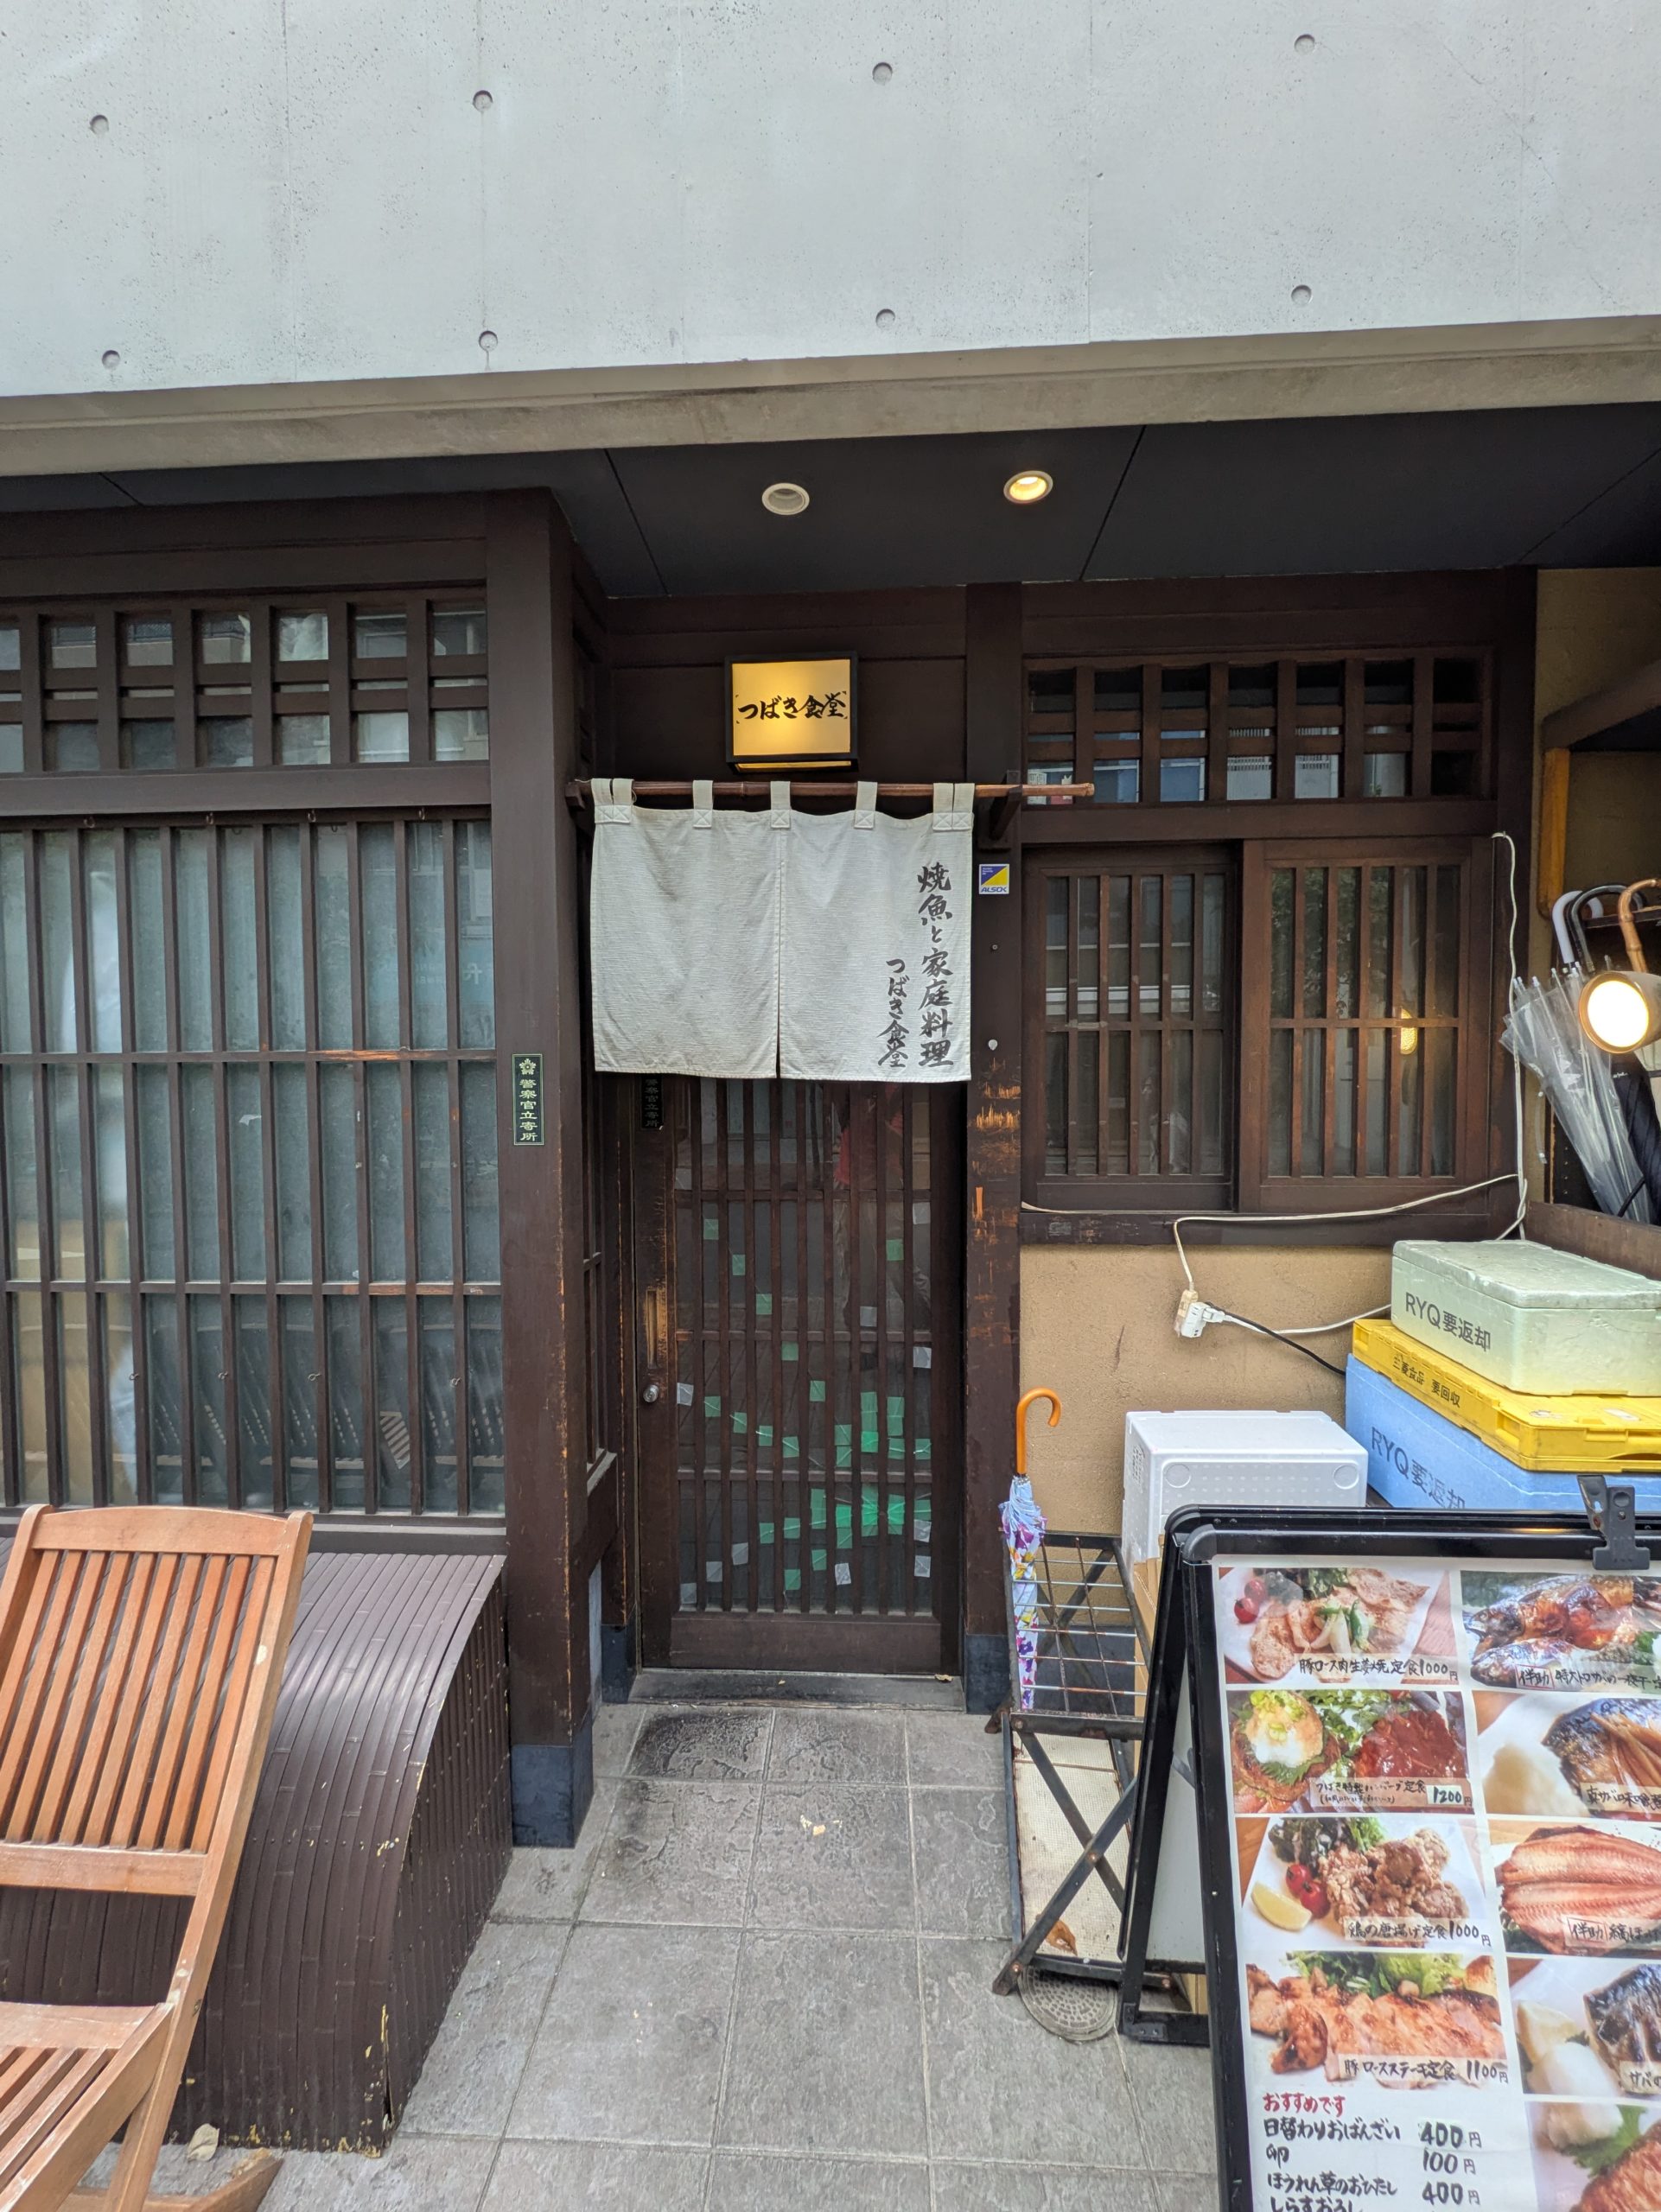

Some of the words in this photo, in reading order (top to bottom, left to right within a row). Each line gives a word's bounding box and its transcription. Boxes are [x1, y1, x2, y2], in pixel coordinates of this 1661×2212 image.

[738, 691, 848, 721] つばき食堂
[918, 861, 954, 1067] 焼魚と家庭料理
[877, 958, 910, 1068] つばき食堂
[519, 1078, 538, 1141] 警察官立寄所
[1405, 1292, 1491, 1352] RYQ要返却
[1431, 1378, 1461, 1408] 要回収
[1263, 2092, 1346, 2118] おすすめです
[1263, 2115, 1402, 2143] 日替わりおばんざい
[1266, 2143, 1290, 2170] 卵
